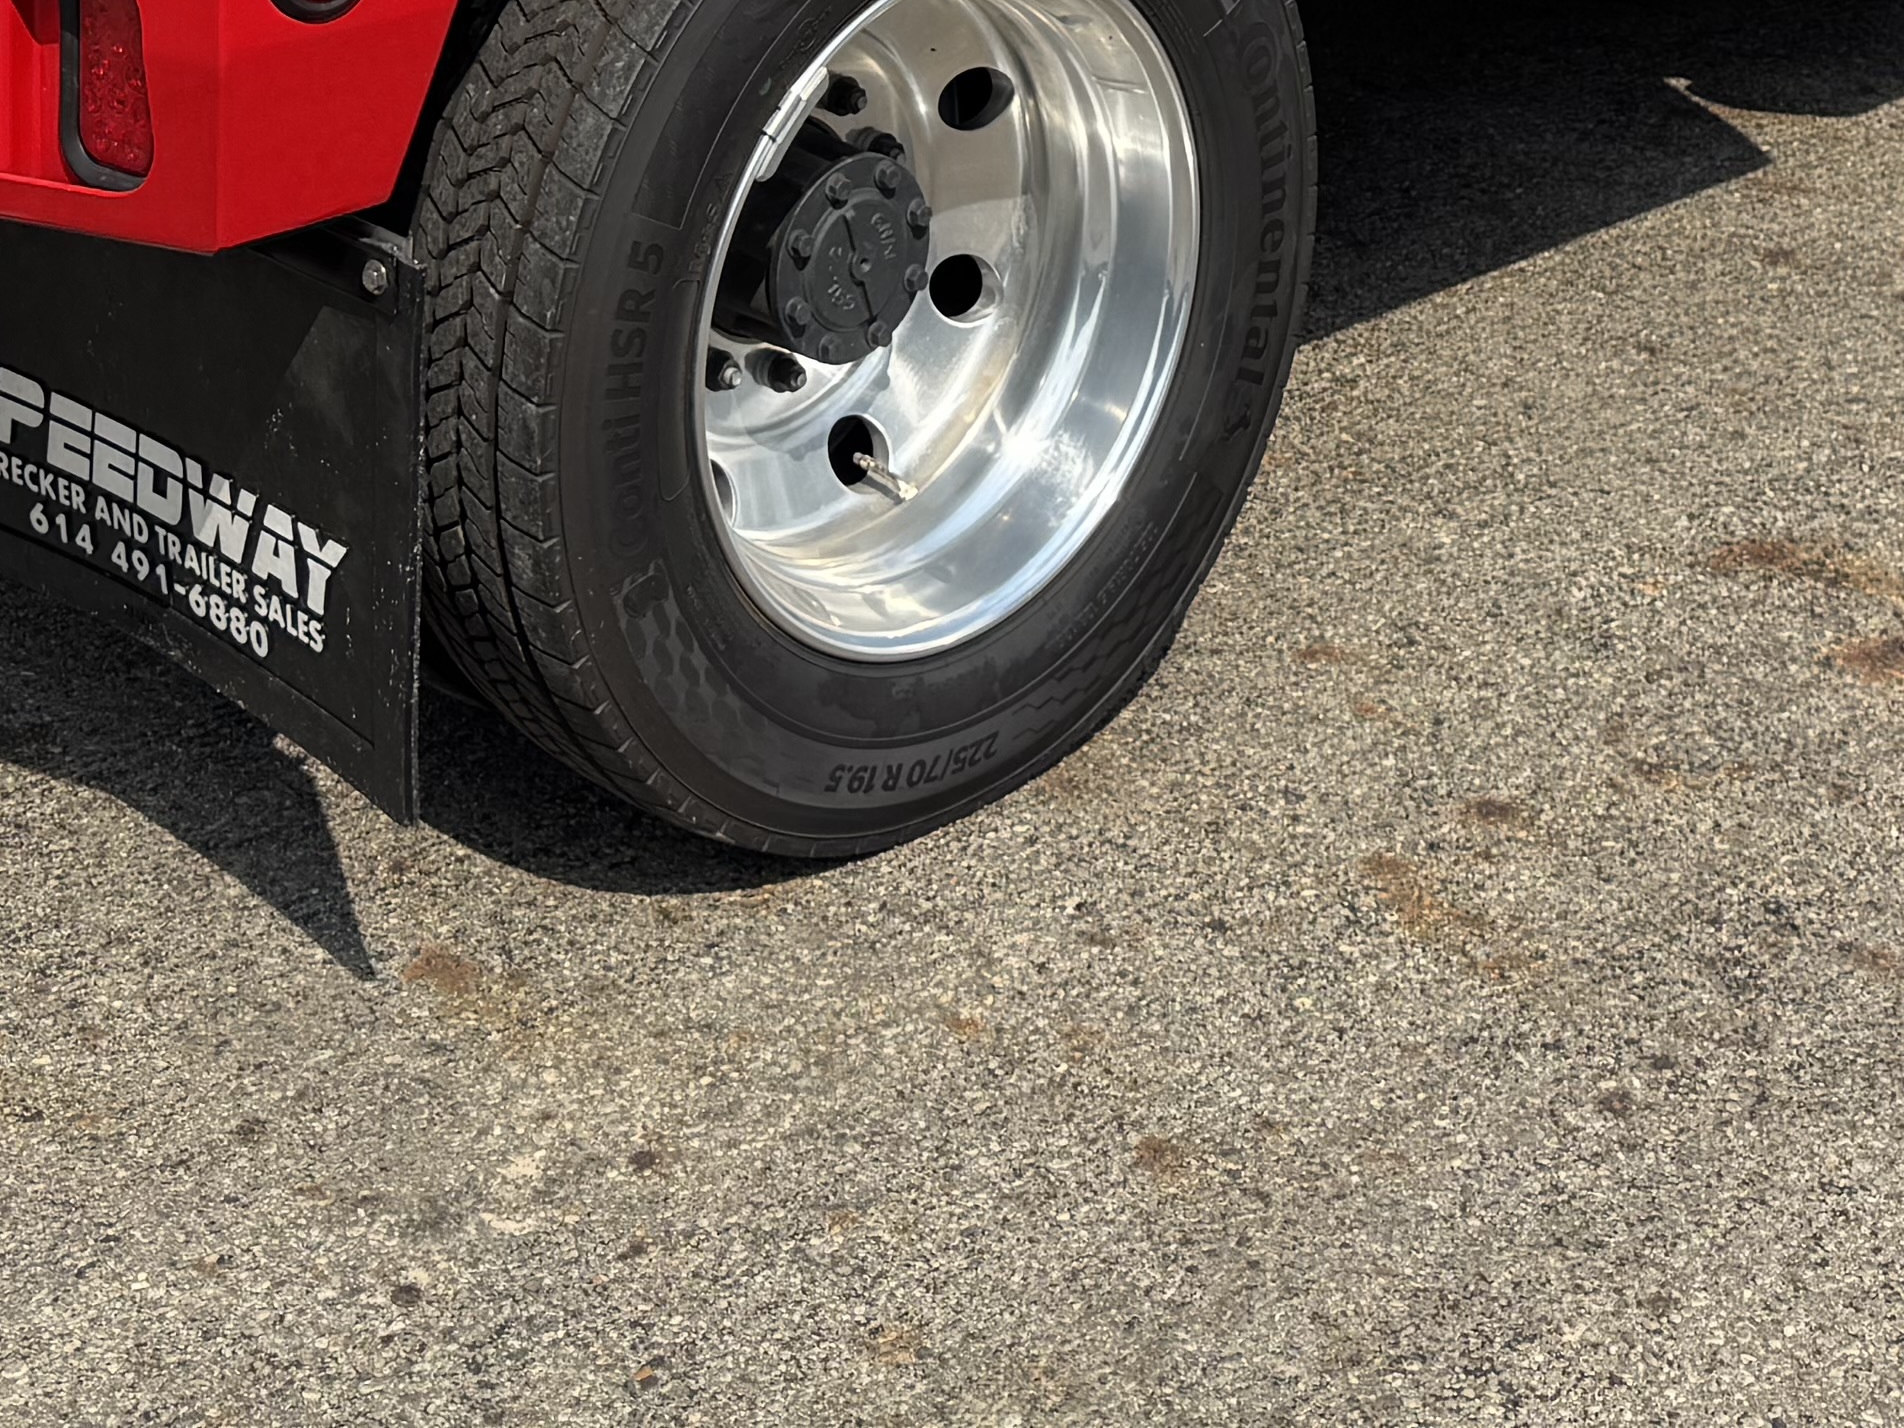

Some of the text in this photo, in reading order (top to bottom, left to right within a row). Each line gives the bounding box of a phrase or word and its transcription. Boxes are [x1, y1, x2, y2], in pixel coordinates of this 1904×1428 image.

[627, 239, 665, 278] 5
[1237, 21, 1289, 385] Continental
[604, 288, 657, 402] HSR
[28, 503, 269, 658] 614 491-6880
[95, 497, 149, 544] AND
[154, 524, 249, 605] TRAILER
[253, 583, 325, 653] SALES
[908, 731, 1001, 789] 225/70
